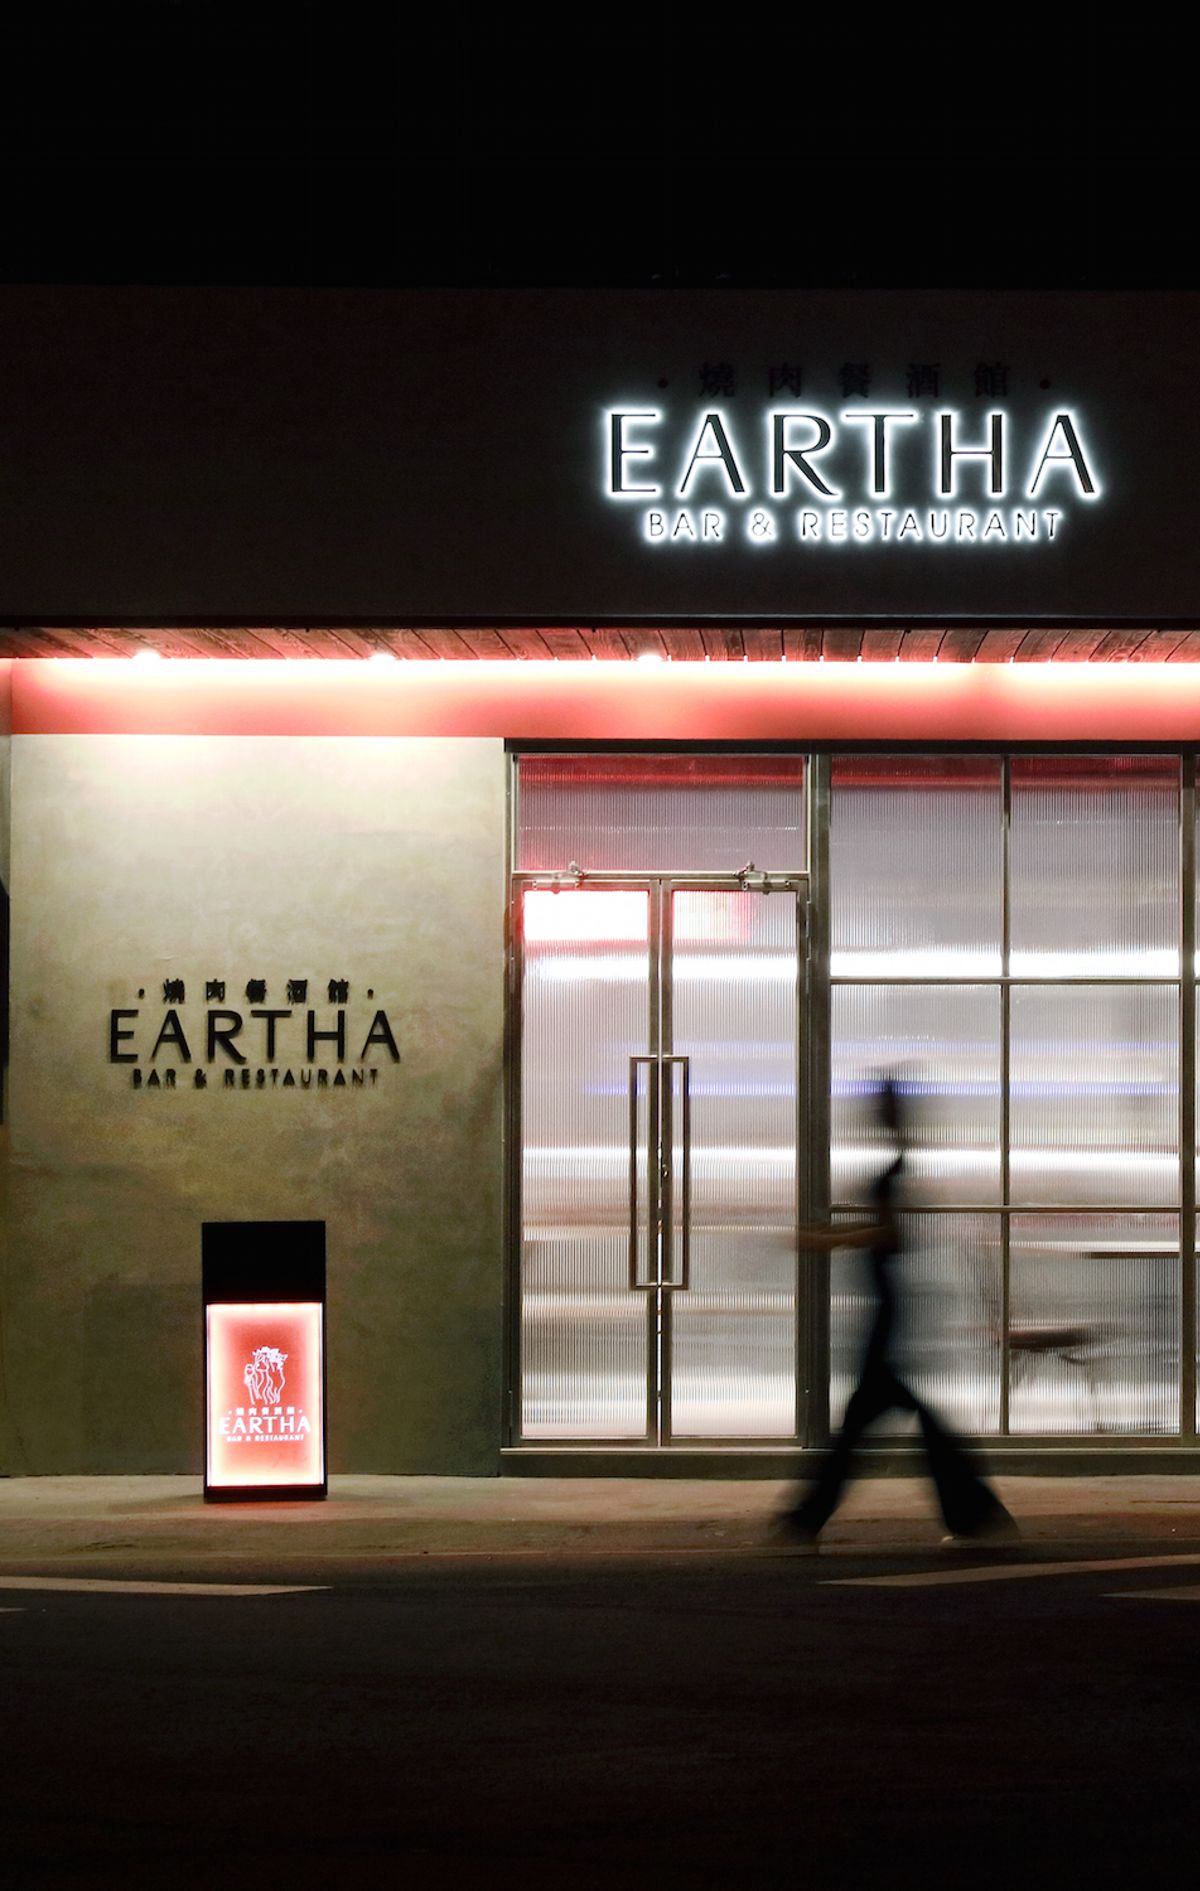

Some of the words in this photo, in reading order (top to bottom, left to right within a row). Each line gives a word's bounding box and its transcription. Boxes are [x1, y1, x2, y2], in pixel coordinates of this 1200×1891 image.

[609, 412, 1098, 496] EARTHA
[648, 512, 722, 538] BAR
[751, 512, 773, 538] &
[801, 512, 1062, 539] RESTAURANT
[110, 1009, 401, 1064] EARTHA
[133, 1068, 177, 1089] BAR
[194, 1068, 207, 1089] &
[225, 1068, 378, 1089] RESTAURANT
[219, 1416, 311, 1434] EARTHA
